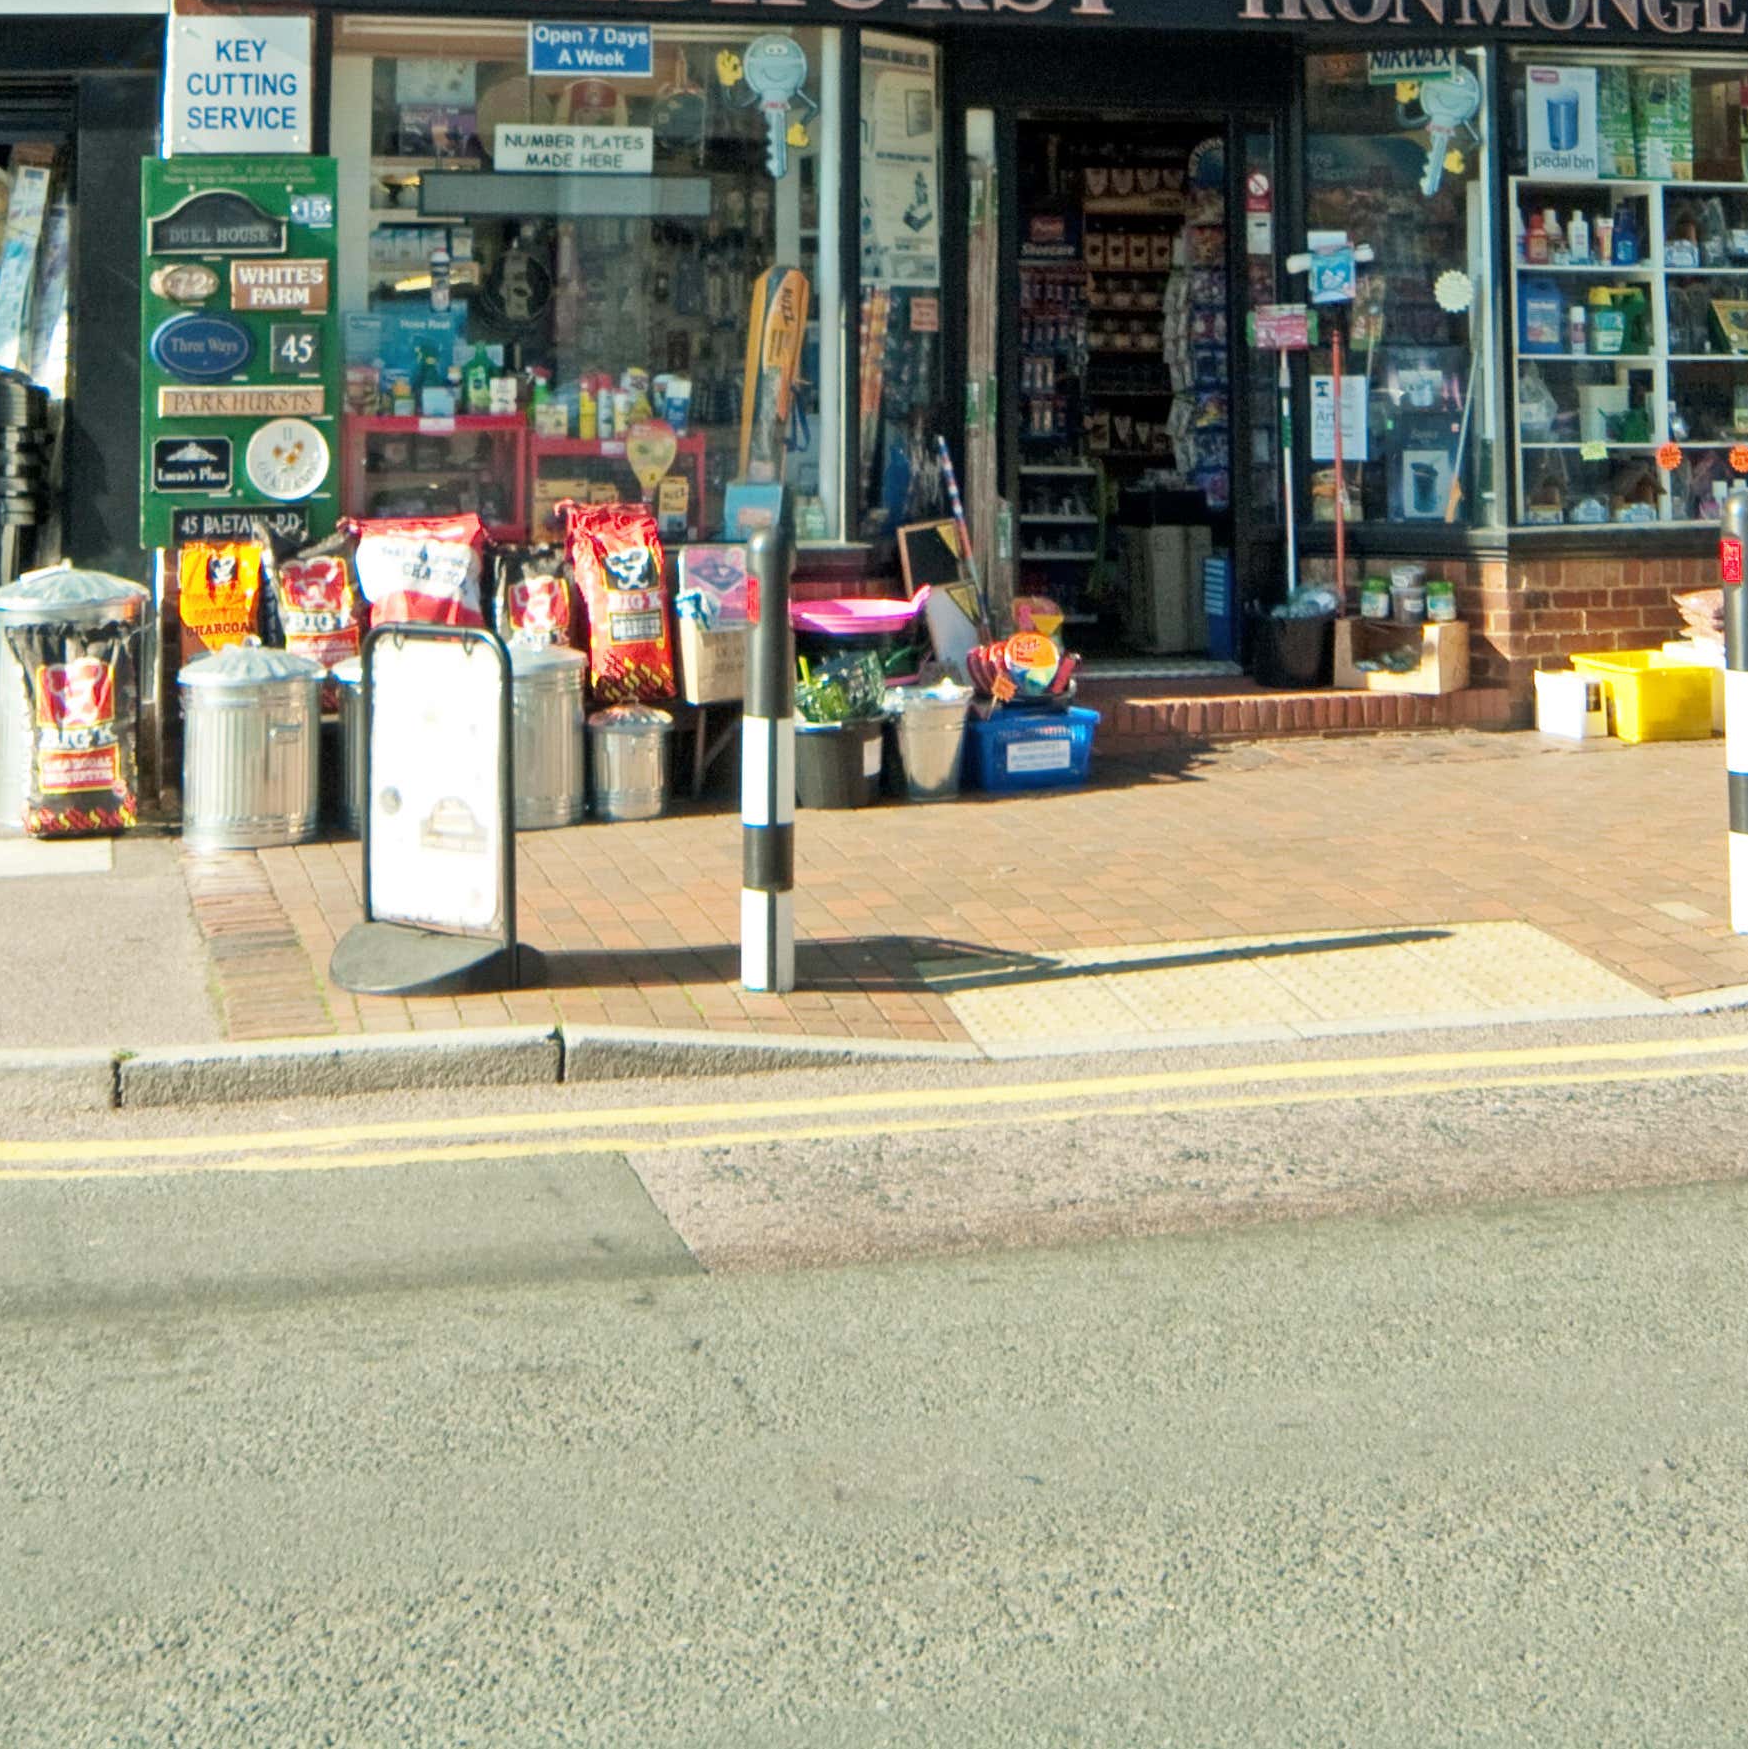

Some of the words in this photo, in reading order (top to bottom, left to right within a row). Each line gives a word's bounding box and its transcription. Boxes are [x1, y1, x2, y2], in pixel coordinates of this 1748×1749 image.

[534, 26, 583, 46] Open
[587, 27, 599, 43] 7
[603, 28, 649, 48] Days
[215, 39, 267, 63] KEY
[557, 49, 573, 65] A
[575, 49, 626, 66] Week
[1369, 48, 1451, 68] NIKWAX
[186, 72, 298, 96] CUTTING
[186, 106, 297, 130] SERVICE
[504, 133, 575, 148] NUMBER
[581, 135, 644, 150] PLATES
[525, 153, 573, 168] MADE
[579, 154, 624, 169] HERE
[1533, 154, 1571, 171] pedal
[1573, 155, 1595, 170] bin
[215, 226, 269, 243] HOUSE
[238, 266, 324, 285] WHITES
[250, 287, 311, 306] FARM
[170, 336, 206, 353] Three
[280, 334, 314, 364] 45
[173, 390, 314, 412] PARKHURSTS
[180, 514, 200, 535] 45
